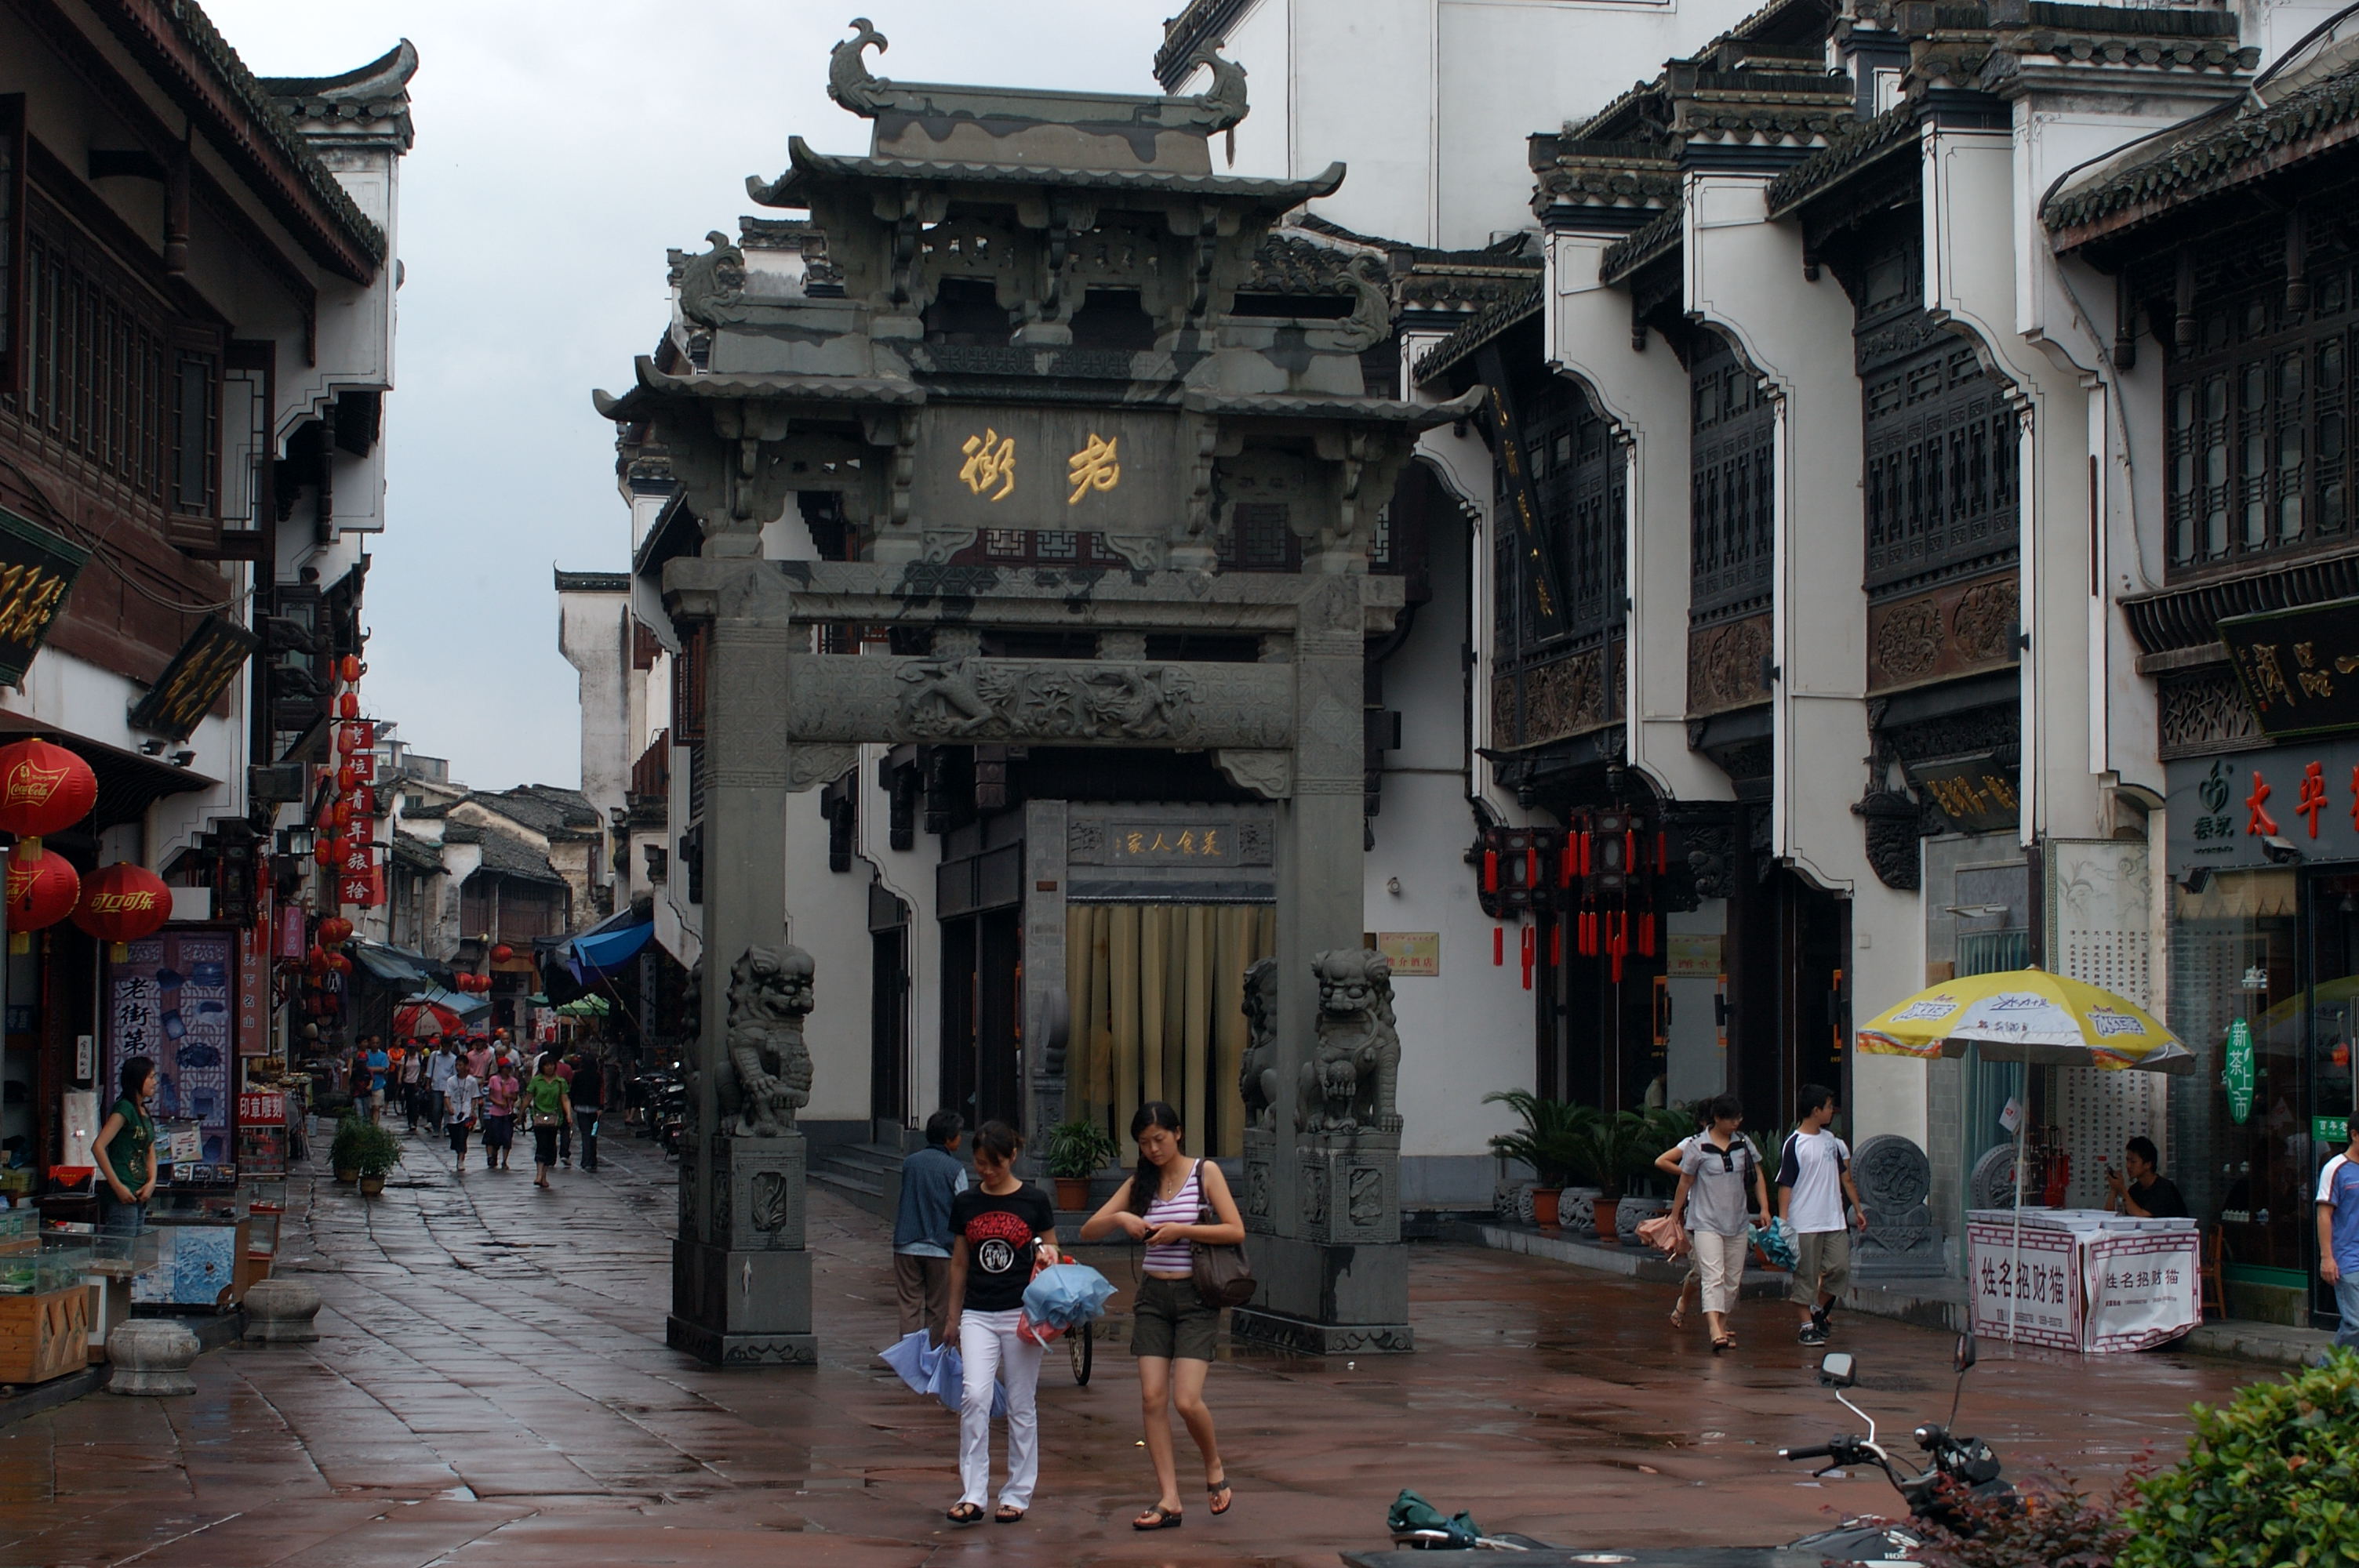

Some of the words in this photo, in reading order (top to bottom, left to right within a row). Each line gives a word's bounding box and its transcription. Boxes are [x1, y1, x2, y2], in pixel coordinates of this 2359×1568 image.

[958, 427, 1120, 506] 老街
[1127, 829, 1223, 856] 美食人家
[91, 890, 156, 913] 可口可乐
[2229, 1022, 2253, 1120] 新茶上市
[239, 1094, 284, 1120] 印章雕刻
[1981, 1255, 2065, 1305] 姓名招财猫
[2105, 1269, 2180, 1290] 姓名招财猫
